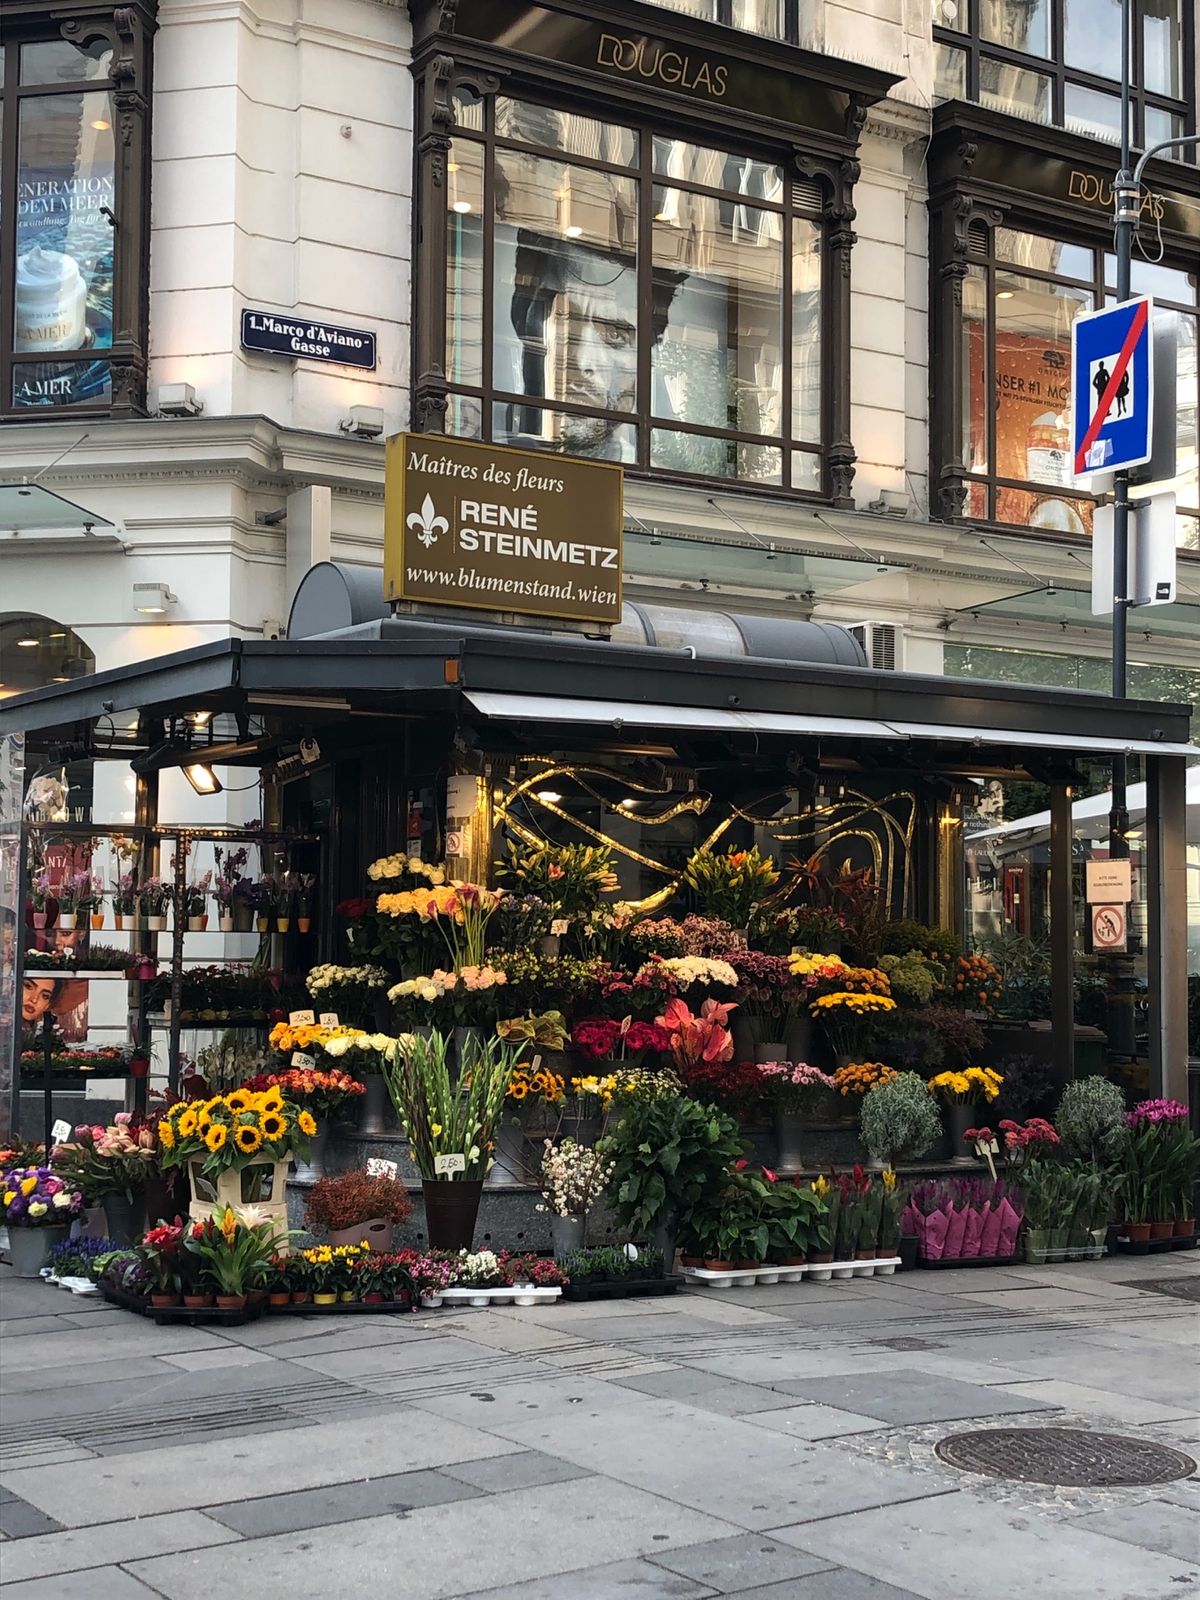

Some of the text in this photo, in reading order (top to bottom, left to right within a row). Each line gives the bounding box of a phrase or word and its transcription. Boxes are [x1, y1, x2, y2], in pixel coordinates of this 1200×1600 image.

[597, 33, 728, 96] DOUGLAS
[18, 194, 111, 214] DEM MEER
[1068, 170, 1165, 220] DOUAS
[262, 317, 304, 338] Marco
[290, 336, 331, 356] Gasse
[36, 380, 73, 395] MER
[1028, 380, 1041, 396] #1
[407, 451, 565, 493] Maîtres des fleurs
[460, 499, 538, 531] RENÉ
[459, 528, 618, 569] STEINMETZ
[406, 566, 618, 605] www.blumenstand.wien
